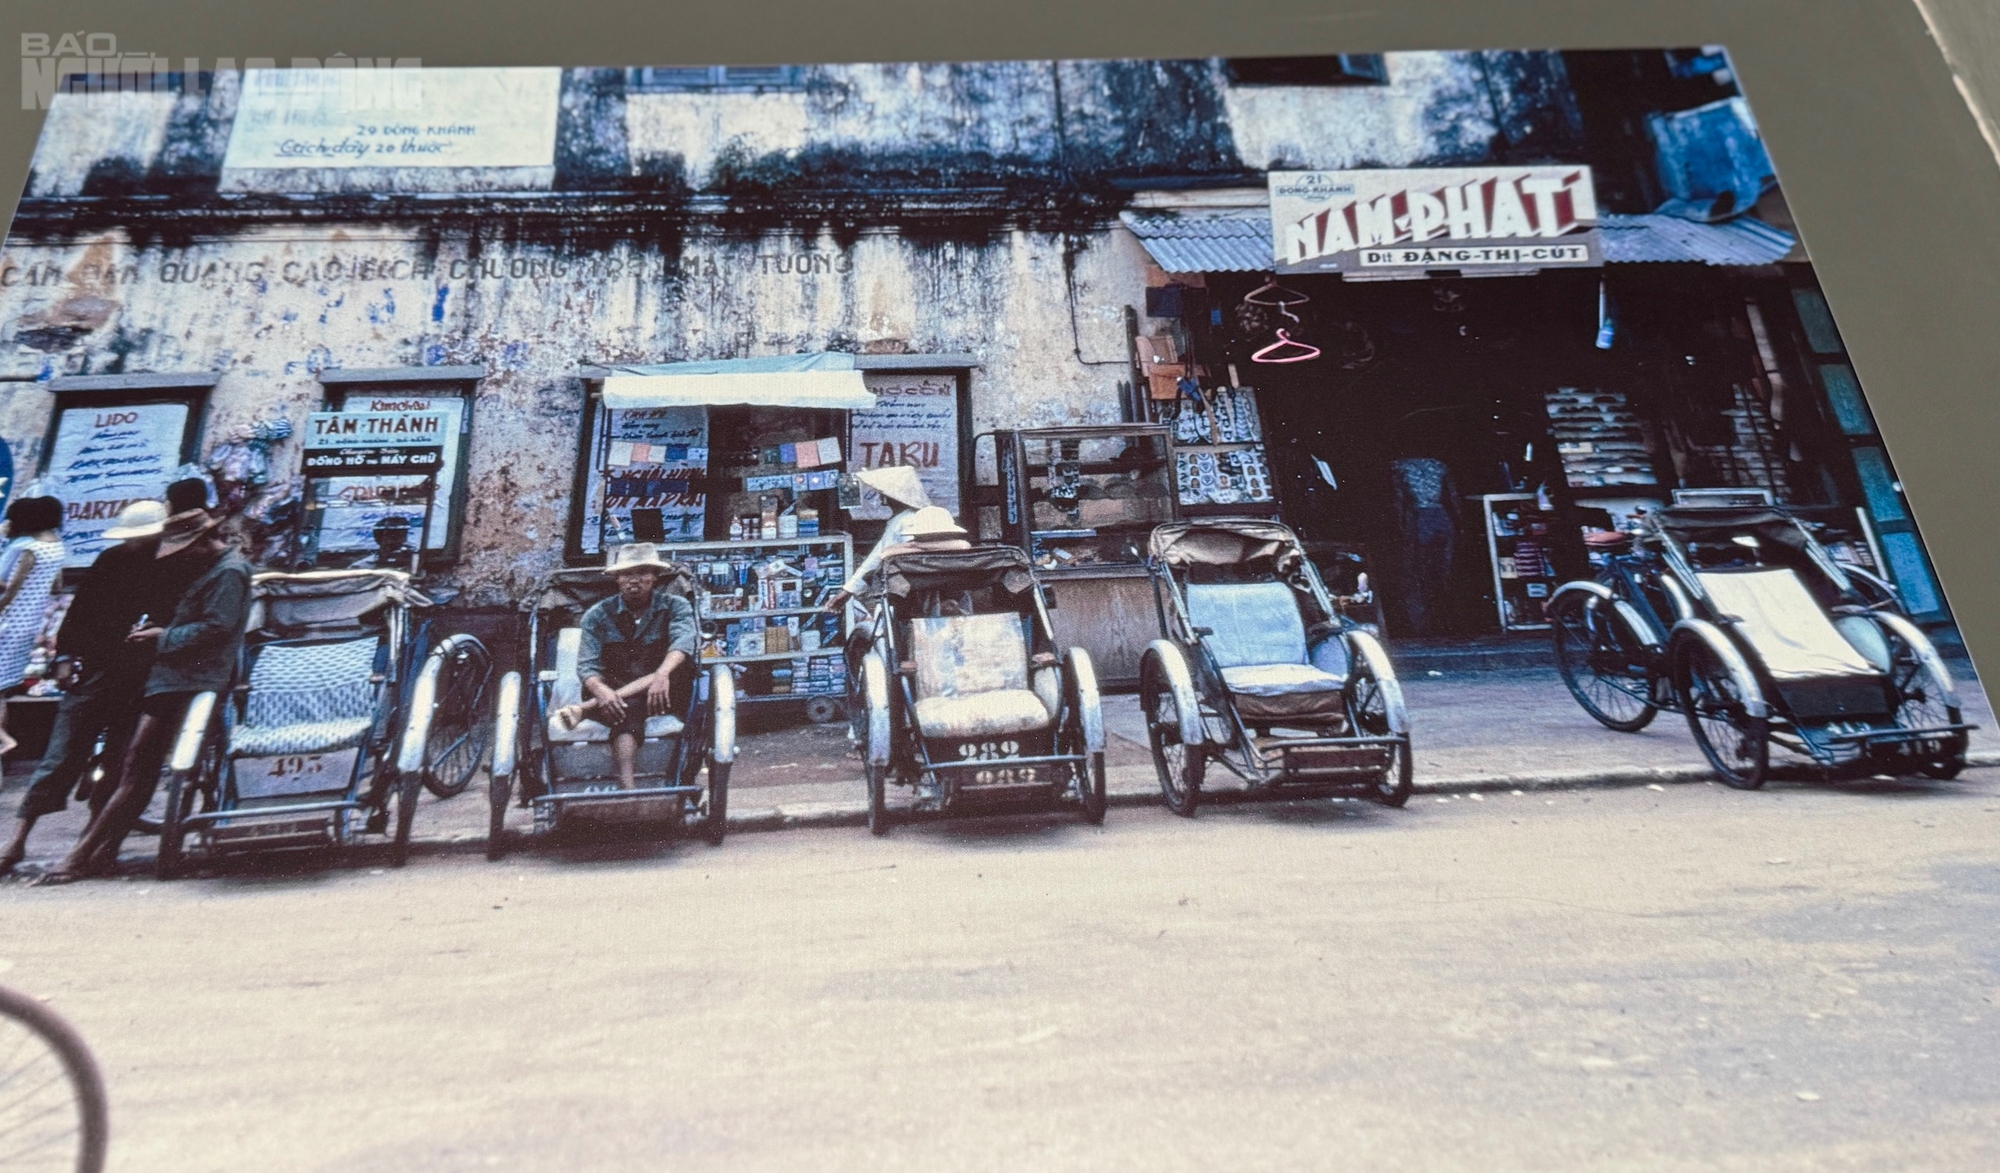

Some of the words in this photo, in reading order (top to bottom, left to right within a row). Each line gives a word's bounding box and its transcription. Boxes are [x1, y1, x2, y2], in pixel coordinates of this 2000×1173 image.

[1306, 175, 1322, 184] 21
[95, 412, 138, 428] LIDO
[268, 756, 323, 777] 495
